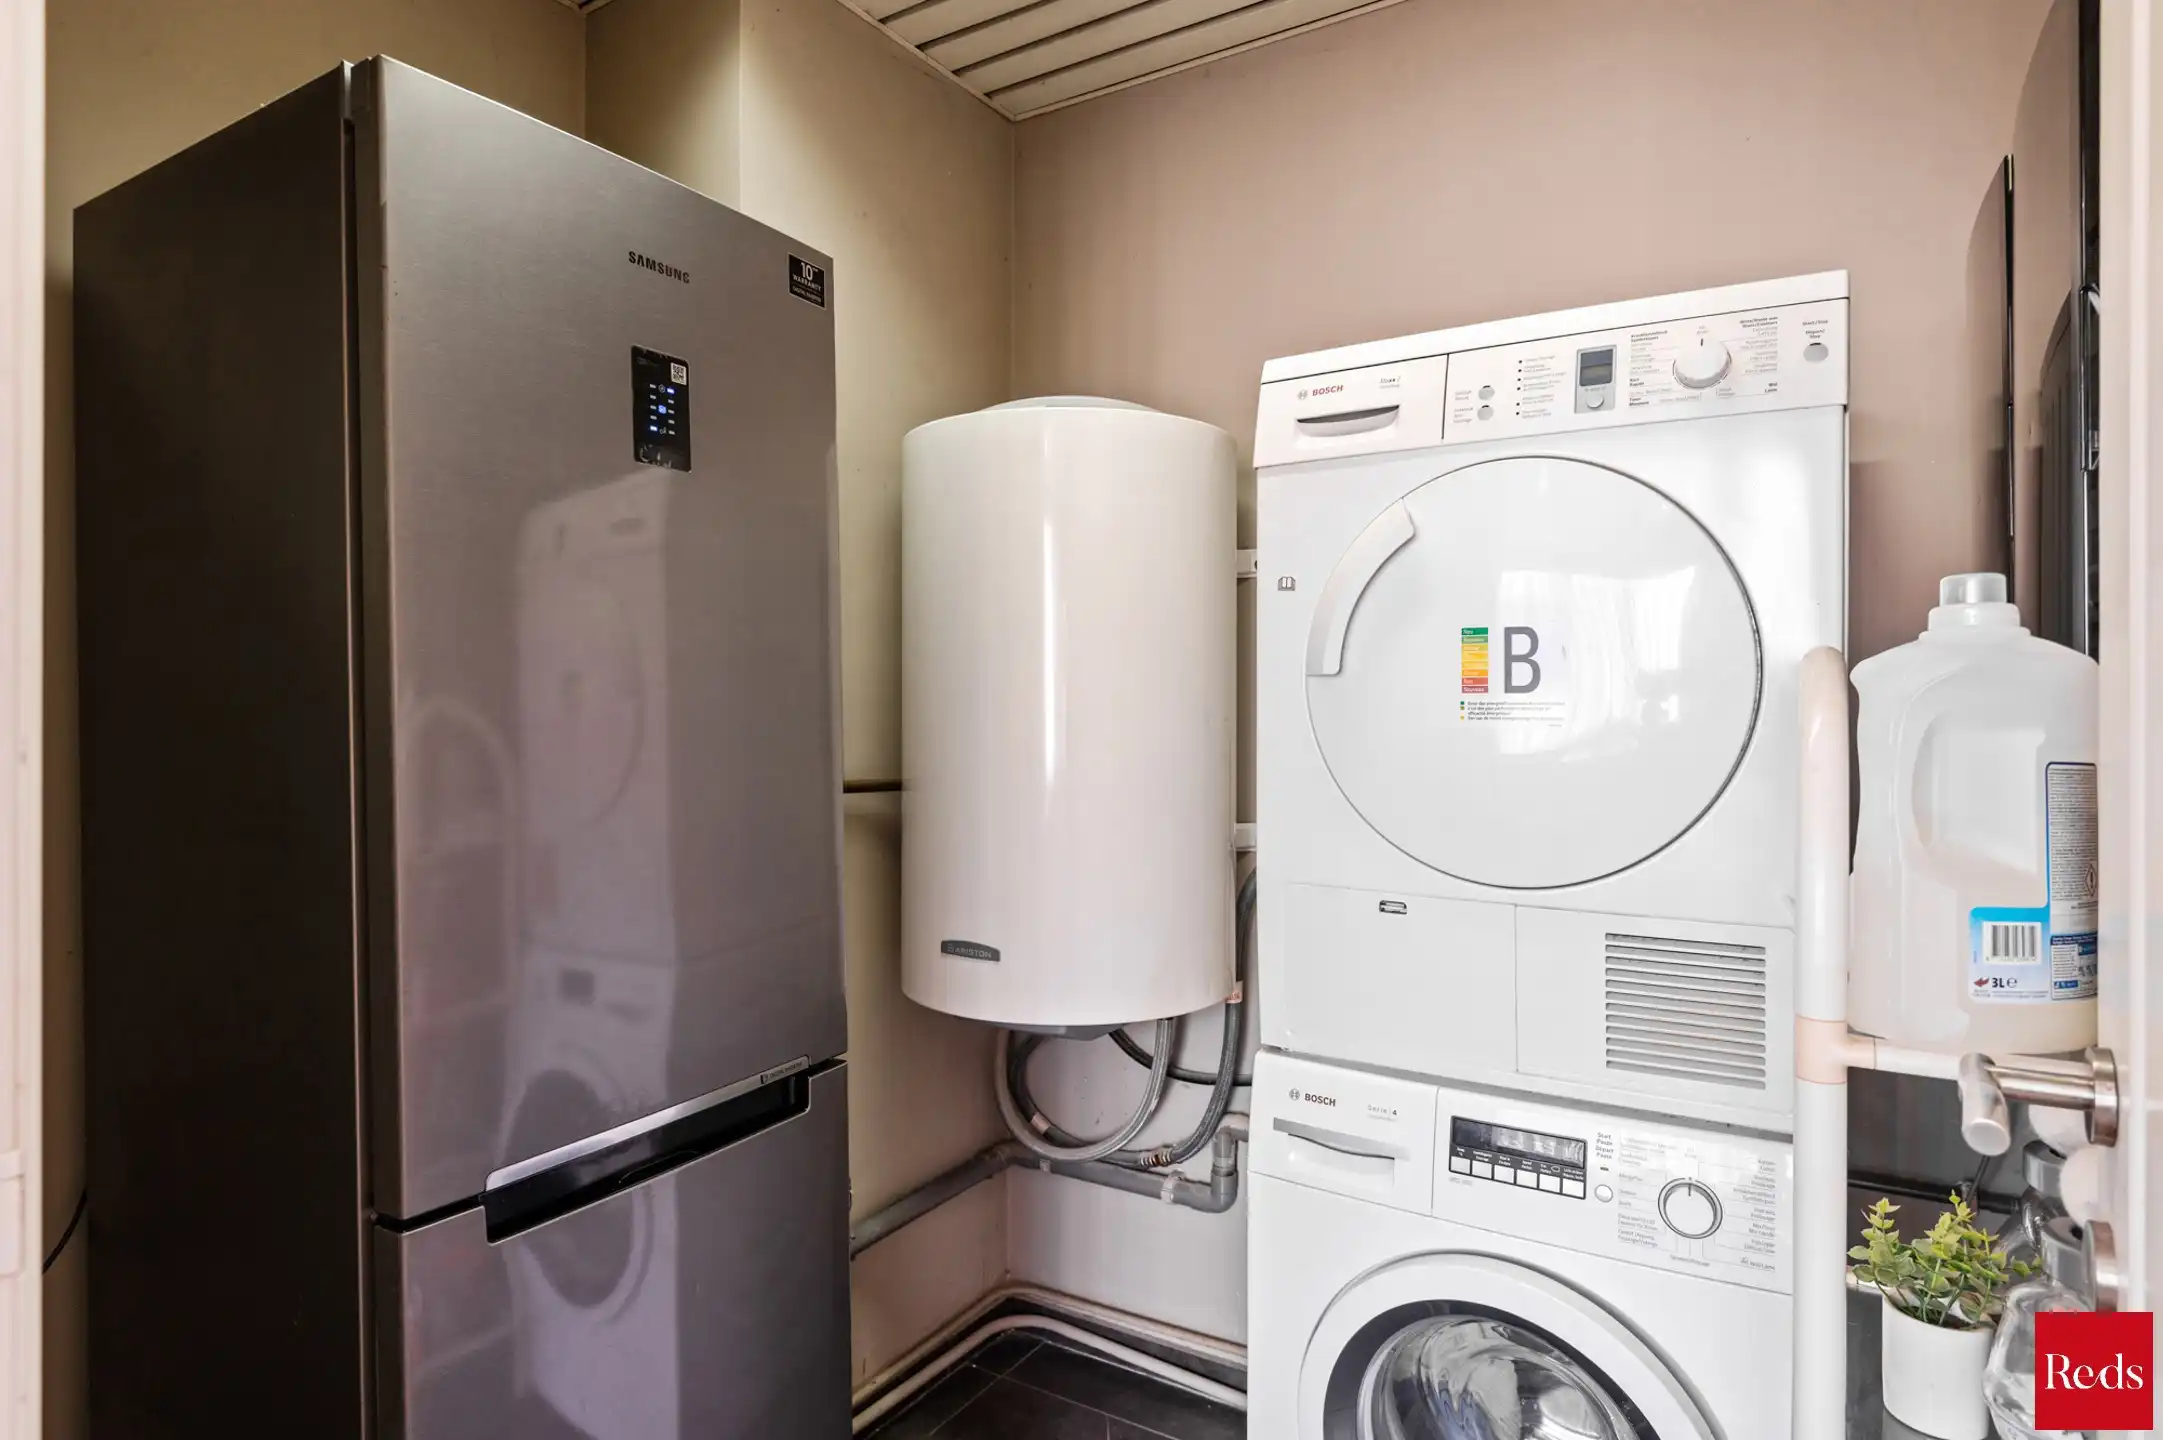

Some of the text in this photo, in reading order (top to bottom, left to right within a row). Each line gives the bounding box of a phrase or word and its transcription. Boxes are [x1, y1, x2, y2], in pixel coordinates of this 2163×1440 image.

[628, 250, 690, 284] SAMSUNG
[800, 262, 814, 281] 10
[1312, 384, 1344, 396] BOSCH
[1503, 626, 1541, 694] B
[1991, 977, 2005, 988] 3L
[1304, 1093, 1336, 1107] BOSCH
